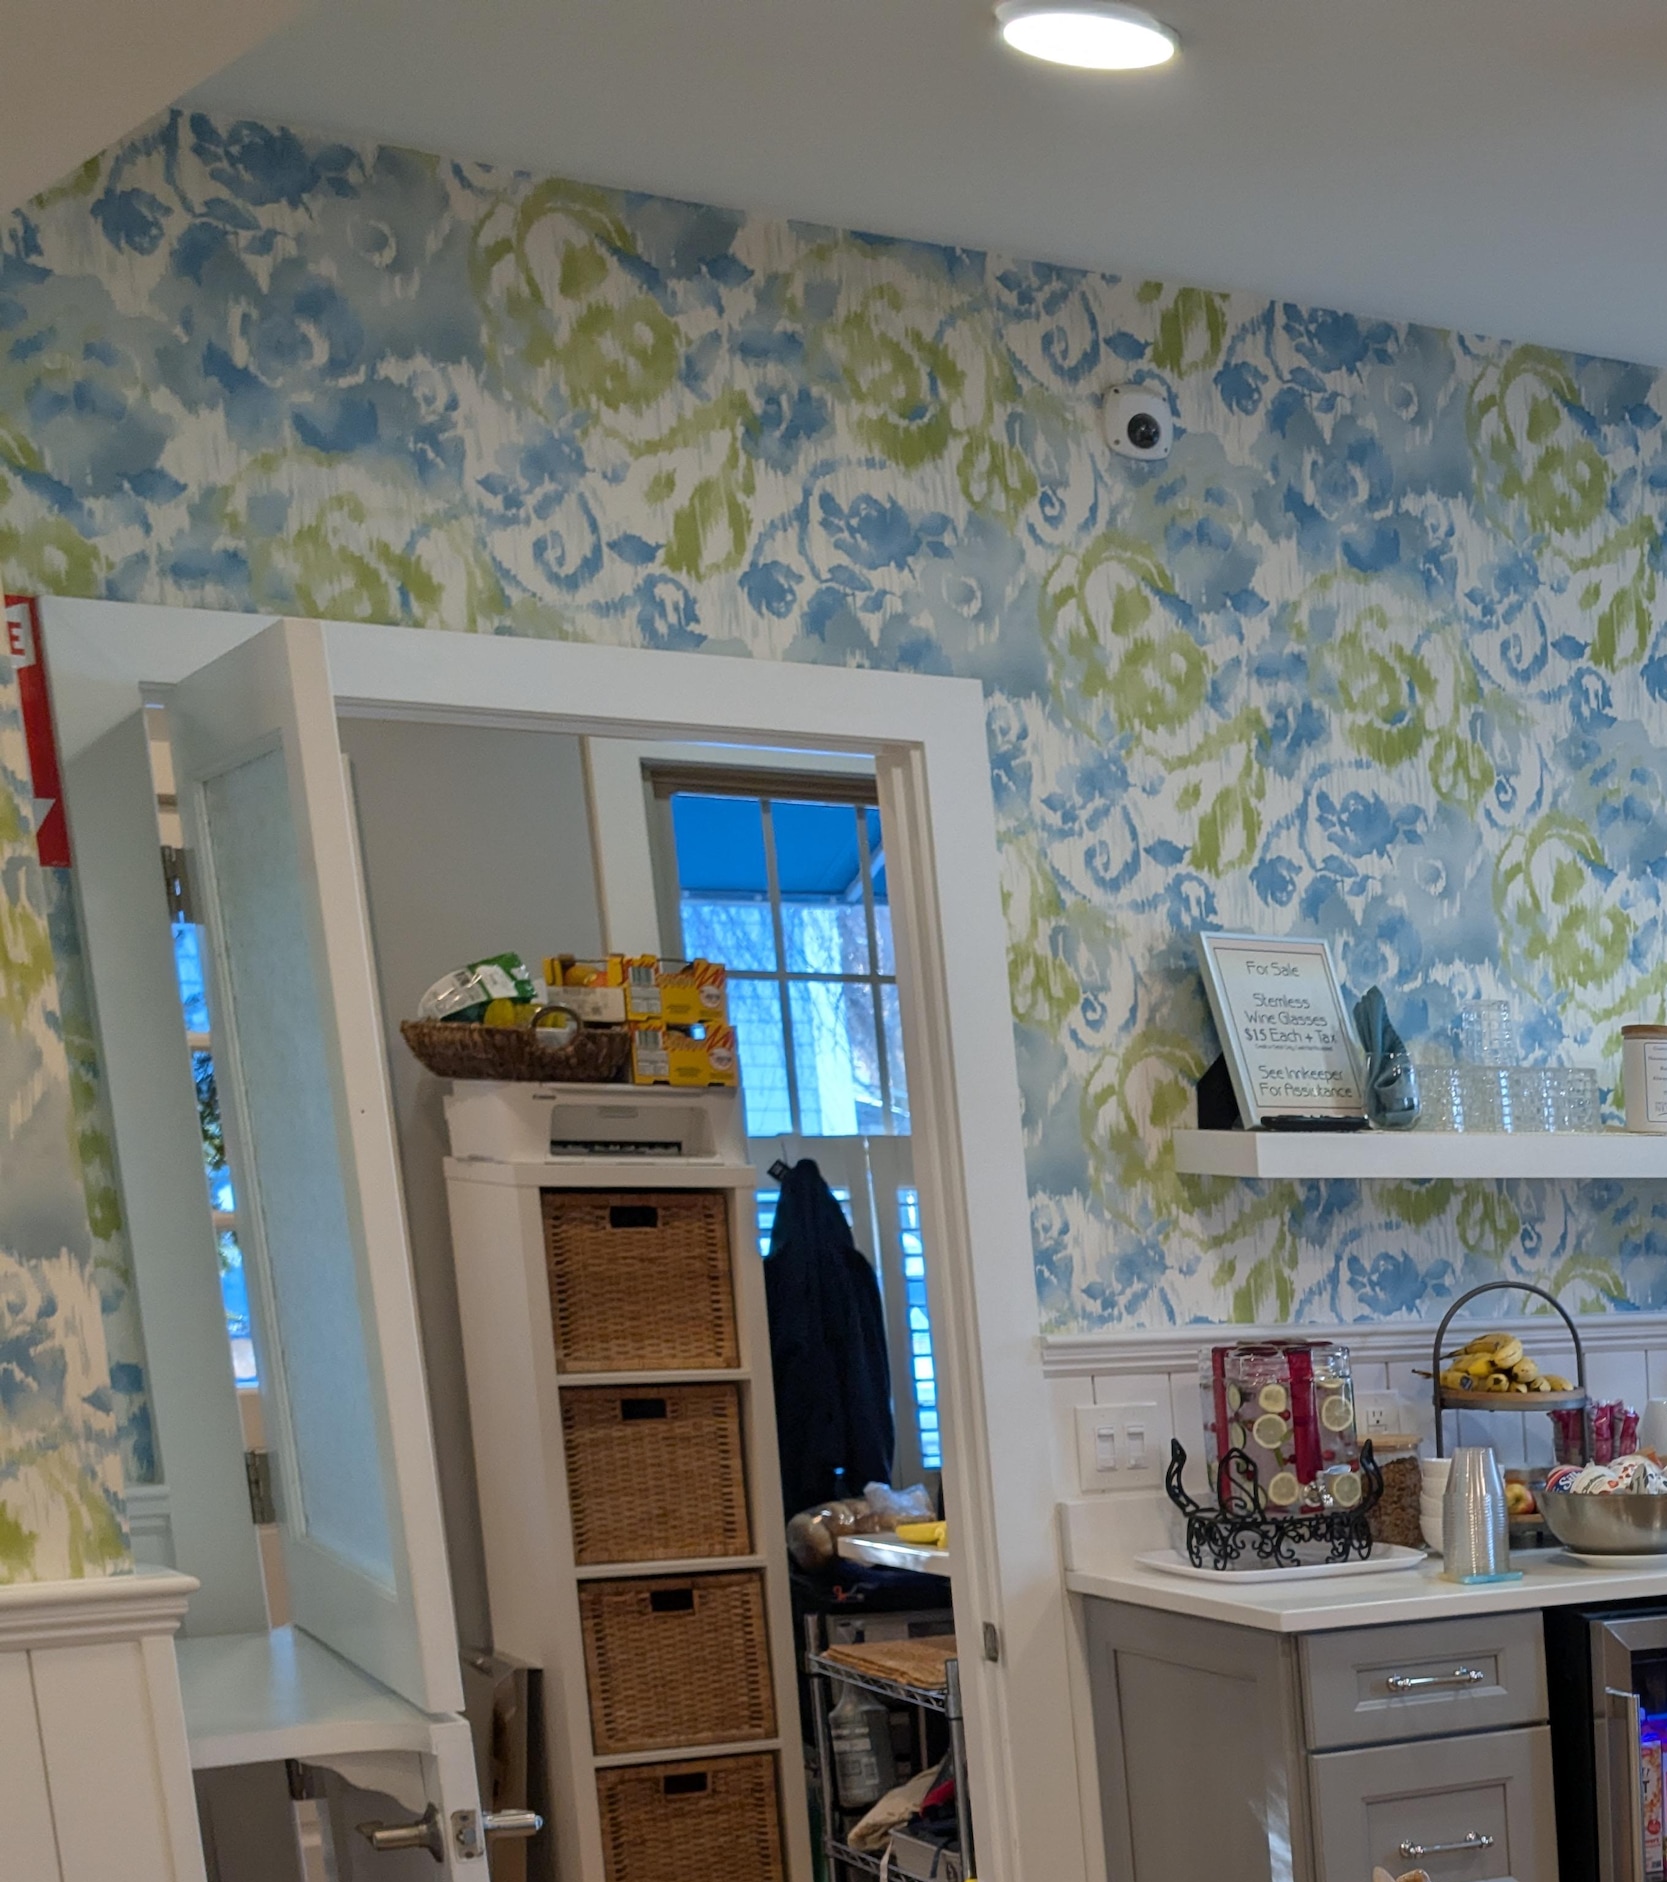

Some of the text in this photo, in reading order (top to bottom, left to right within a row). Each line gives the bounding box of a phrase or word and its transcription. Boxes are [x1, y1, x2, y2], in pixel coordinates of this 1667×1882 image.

[1246, 960, 1300, 977] For Sale
[1253, 993, 1311, 1009] Stemless
[1244, 1010, 1328, 1027] Wine Glasses
[1244, 1027, 1267, 1042] $15
[1269, 1028, 1302, 1043] Each
[1315, 1029, 1337, 1044] Tax
[1258, 1065, 1344, 1083] See Innkeeper
[1259, 1083, 1353, 1099] For Assistance
